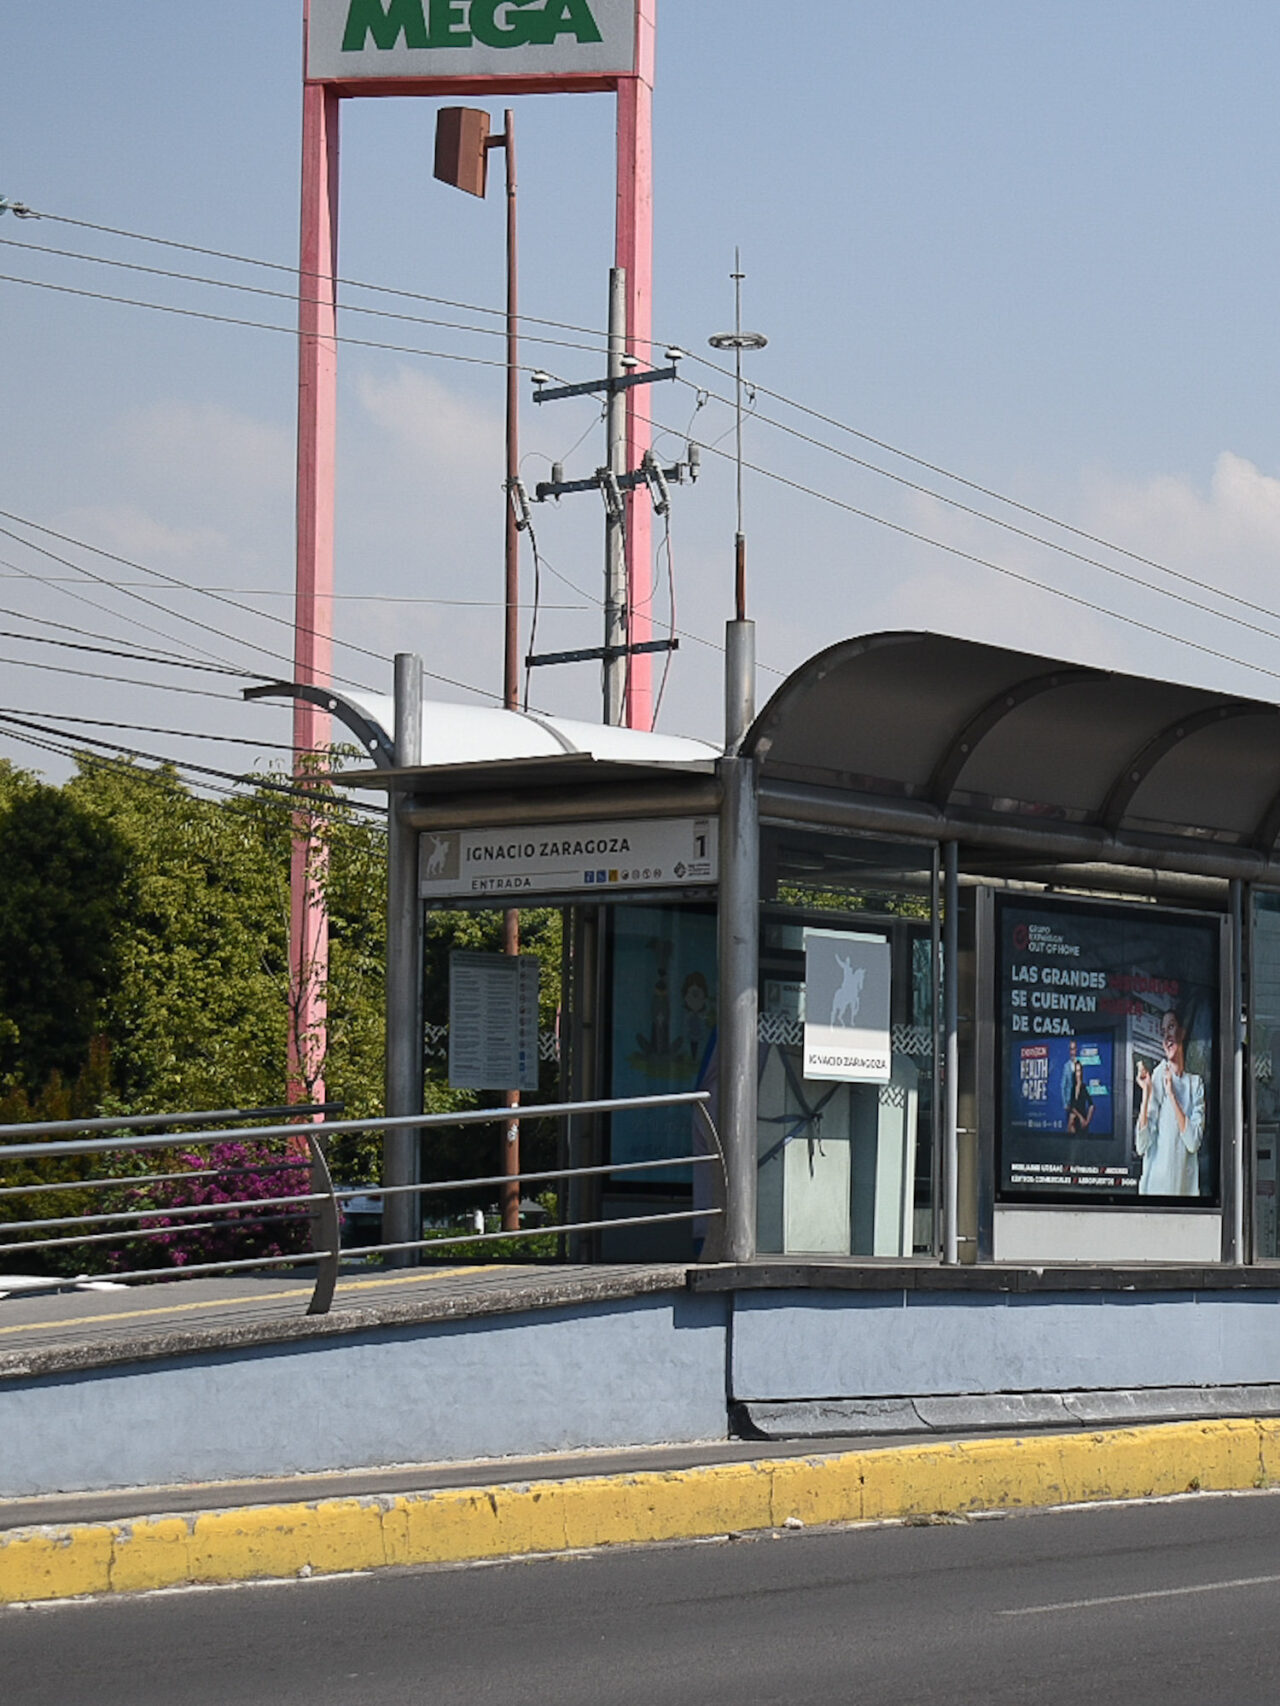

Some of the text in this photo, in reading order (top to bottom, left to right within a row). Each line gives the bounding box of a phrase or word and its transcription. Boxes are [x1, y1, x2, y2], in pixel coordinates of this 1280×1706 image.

[341, 0, 603, 52] MEGA
[466, 838, 630, 862] IGNACIO ZARAGOZA
[695, 835, 705, 857] 1
[471, 878, 531, 890] ENTRADA
[1011, 965, 1038, 984] LAS
[1041, 967, 1106, 989] GRANDES
[1011, 990, 1027, 1007] SE
[1031, 992, 1096, 1012] CUENTAN
[1012, 1014, 1074, 1035] DE CASA.
